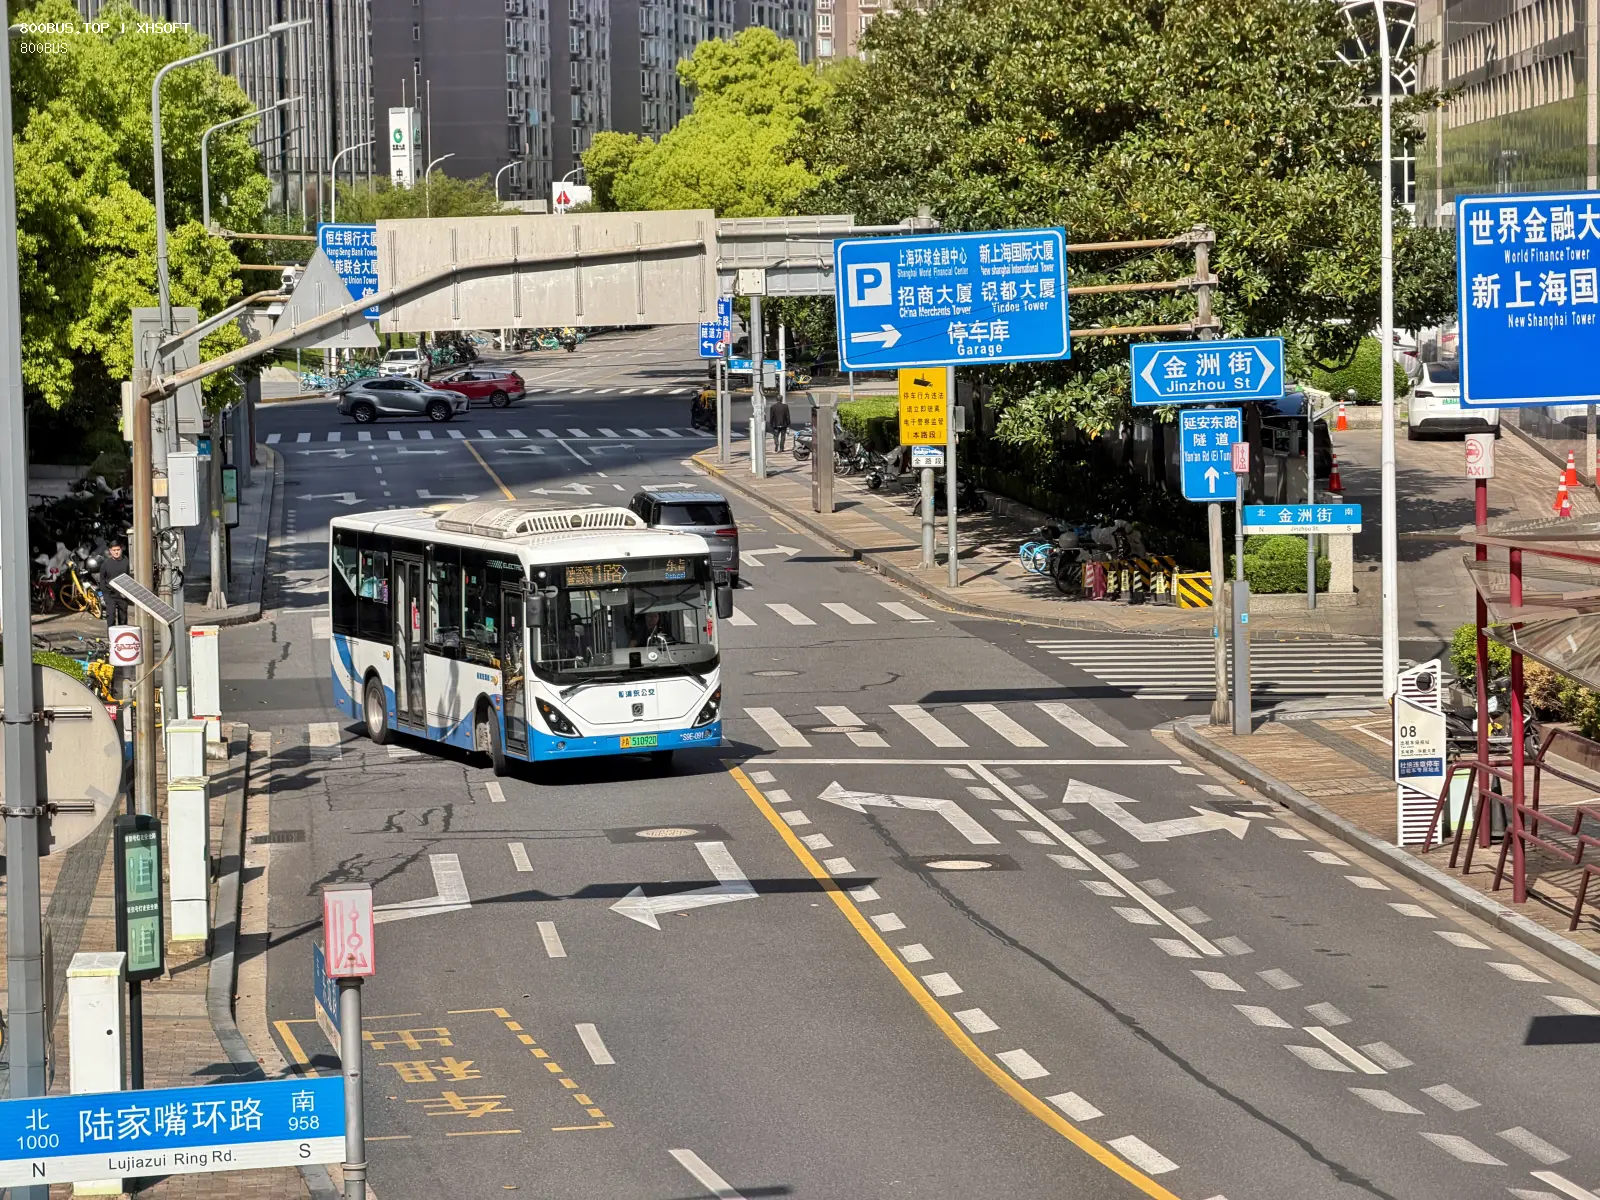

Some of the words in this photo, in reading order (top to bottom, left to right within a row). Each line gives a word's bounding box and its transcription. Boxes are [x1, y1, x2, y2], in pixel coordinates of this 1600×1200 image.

[1469, 203, 1600, 246] 世界金融大
[326, 247, 338, 258] Hang
[339, 247, 351, 258] Seng
[351, 247, 364, 257] Bank
[364, 247, 378, 257] Towe
[897, 247, 968, 268] 上海环球金融中心
[979, 240, 1055, 264] 新上海国际大厦
[1504, 248, 1529, 264] World
[1530, 247, 1564, 263] Finance
[1566, 246, 1590, 261] Tower
[329, 258, 379, 275] 能联合大厦
[896, 268, 918, 279] Shanghai
[919, 267, 932, 277] World
[933, 266, 953, 277] Financial
[954, 266, 969, 276] Center
[1011, 262, 1039, 275] International
[1040, 261, 1055, 273] Tower
[348, 275, 362, 285] Union
[362, 275, 378, 285] Tower
[855, 267, 883, 301] P
[897, 282, 973, 307] 招商大厦
[981, 278, 1056, 302] 银都大厦
[1471, 267, 1599, 310] 新上海国
[899, 306, 917, 318] China
[918, 305, 951, 317] Merchants
[951, 304, 972, 316] Tower
[1022, 299, 1049, 312] Tower
[1508, 313, 1526, 328] New
[1527, 311, 1568, 331] Shanghai
[1571, 311, 1596, 325] Tower
[701, 327, 729, 339] 隧道方
[947, 319, 1010, 345] 停车库
[957, 344, 1003, 357] Garage
[1163, 350, 1253, 379] 金洲街
[1166, 379, 1226, 393] Jinzhou
[1233, 377, 1251, 389] St
[903, 391, 945, 400] 停车行为违法
[903, 417, 944, 427] 电子警察监管
[1183, 414, 1238, 431] 延安东路
[1193, 432, 1230, 447] 隧道
[914, 457, 942, 465] 全路段
[1202, 450, 1210, 462] Rd
[1211, 449, 1219, 462] (E)
[1219, 449, 1232, 462] Tun
[1466, 465, 1485, 476] AXI
[1257, 508, 1266, 517] 北
[1277, 507, 1333, 523] 金洲街
[1344, 507, 1354, 517] 南
[502, 561, 524, 572] ELECTRIC
[1400, 725, 1417, 738] 08
[25, 1108, 50, 1131] 北
[78, 1096, 265, 1144] 陆家嘴环路
[290, 1088, 316, 1114] 南
[16, 1133, 60, 1151] 1000
[288, 1115, 320, 1131] 958
[32, 1162, 46, 1177] N
[108, 1154, 167, 1173] Lujiazui
[173, 1152, 208, 1168] Ring
[212, 1149, 238, 1163] Rd.
[298, 1143, 312, 1159] S
